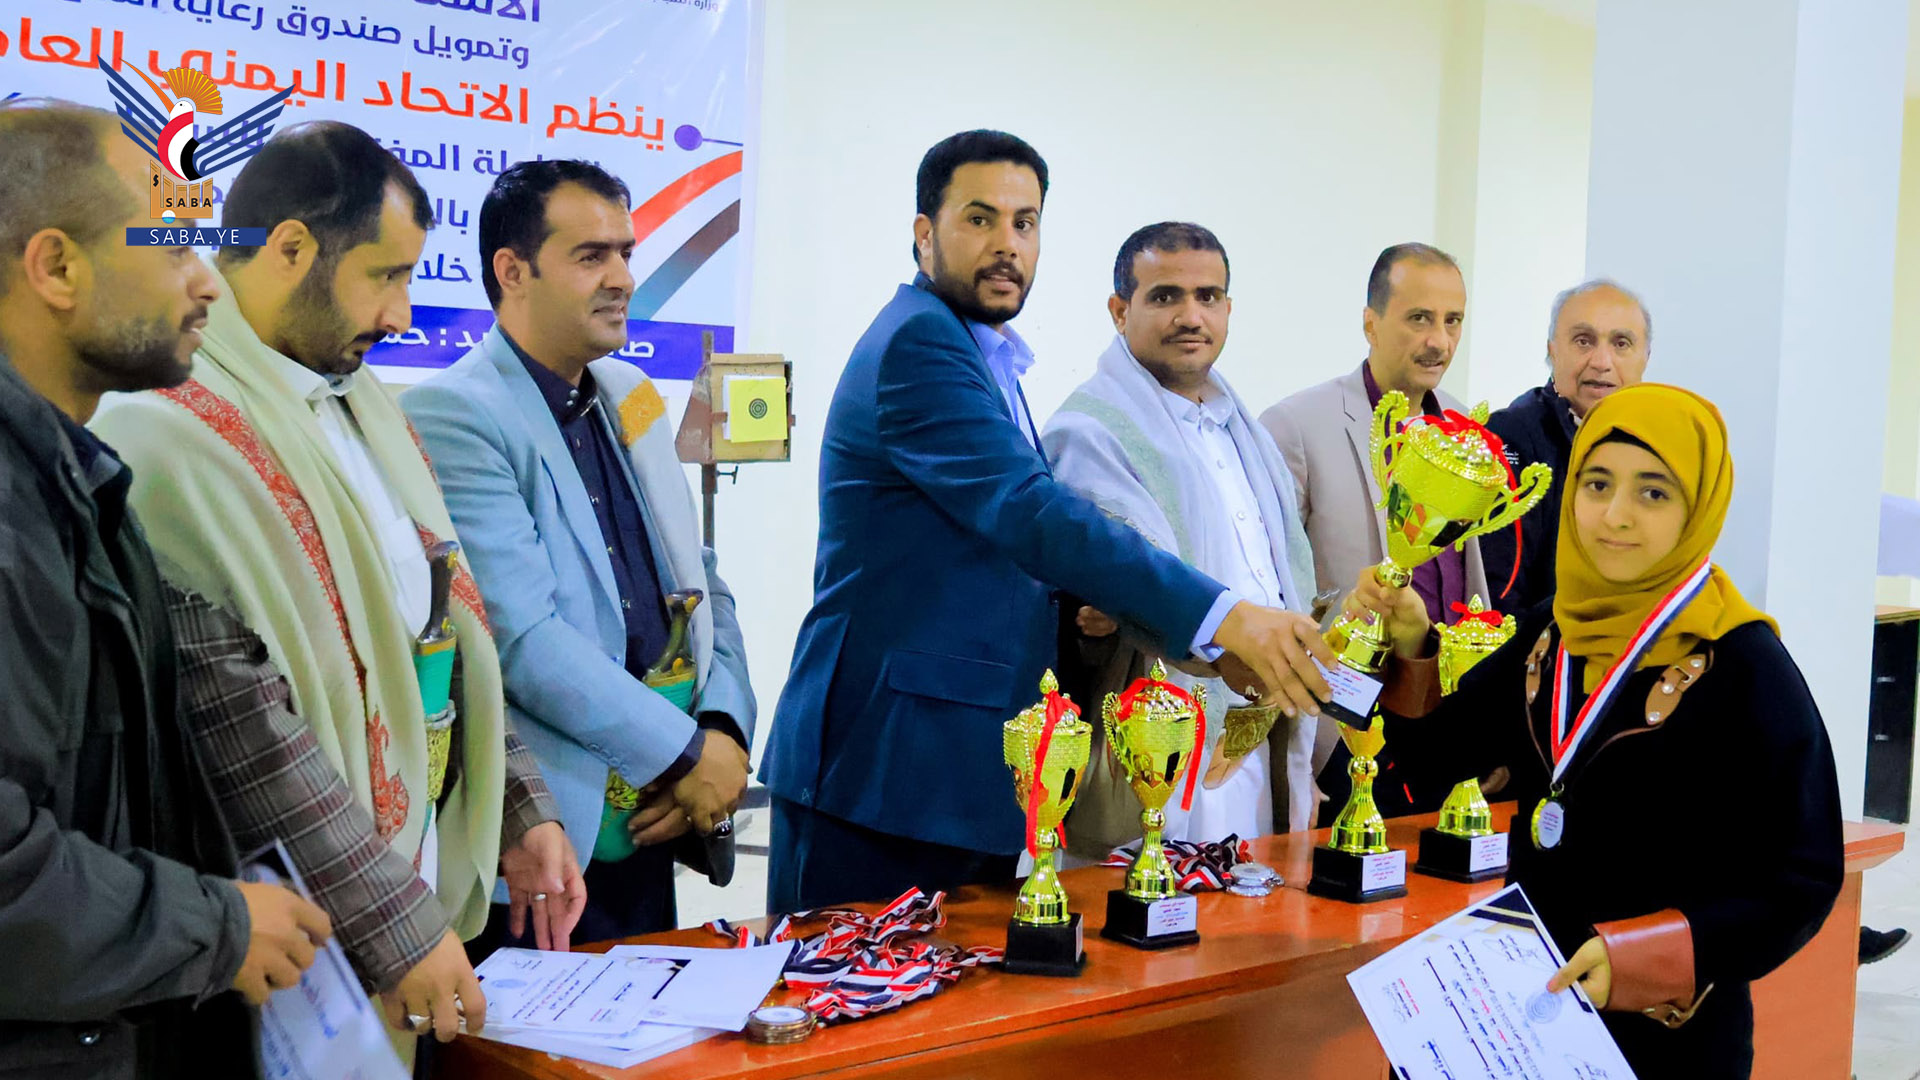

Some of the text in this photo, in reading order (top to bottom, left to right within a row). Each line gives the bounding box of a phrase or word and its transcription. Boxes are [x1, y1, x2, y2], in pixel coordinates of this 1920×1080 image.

[276, 5, 400, 44] صندوق
[413, 25, 529, 70] وتمويل
[147, 48, 346, 108] اليمني
[362, 71, 529, 125] الاتحاد
[546, 96, 664, 151] ينظم
[411, 253, 473, 284] خلا
